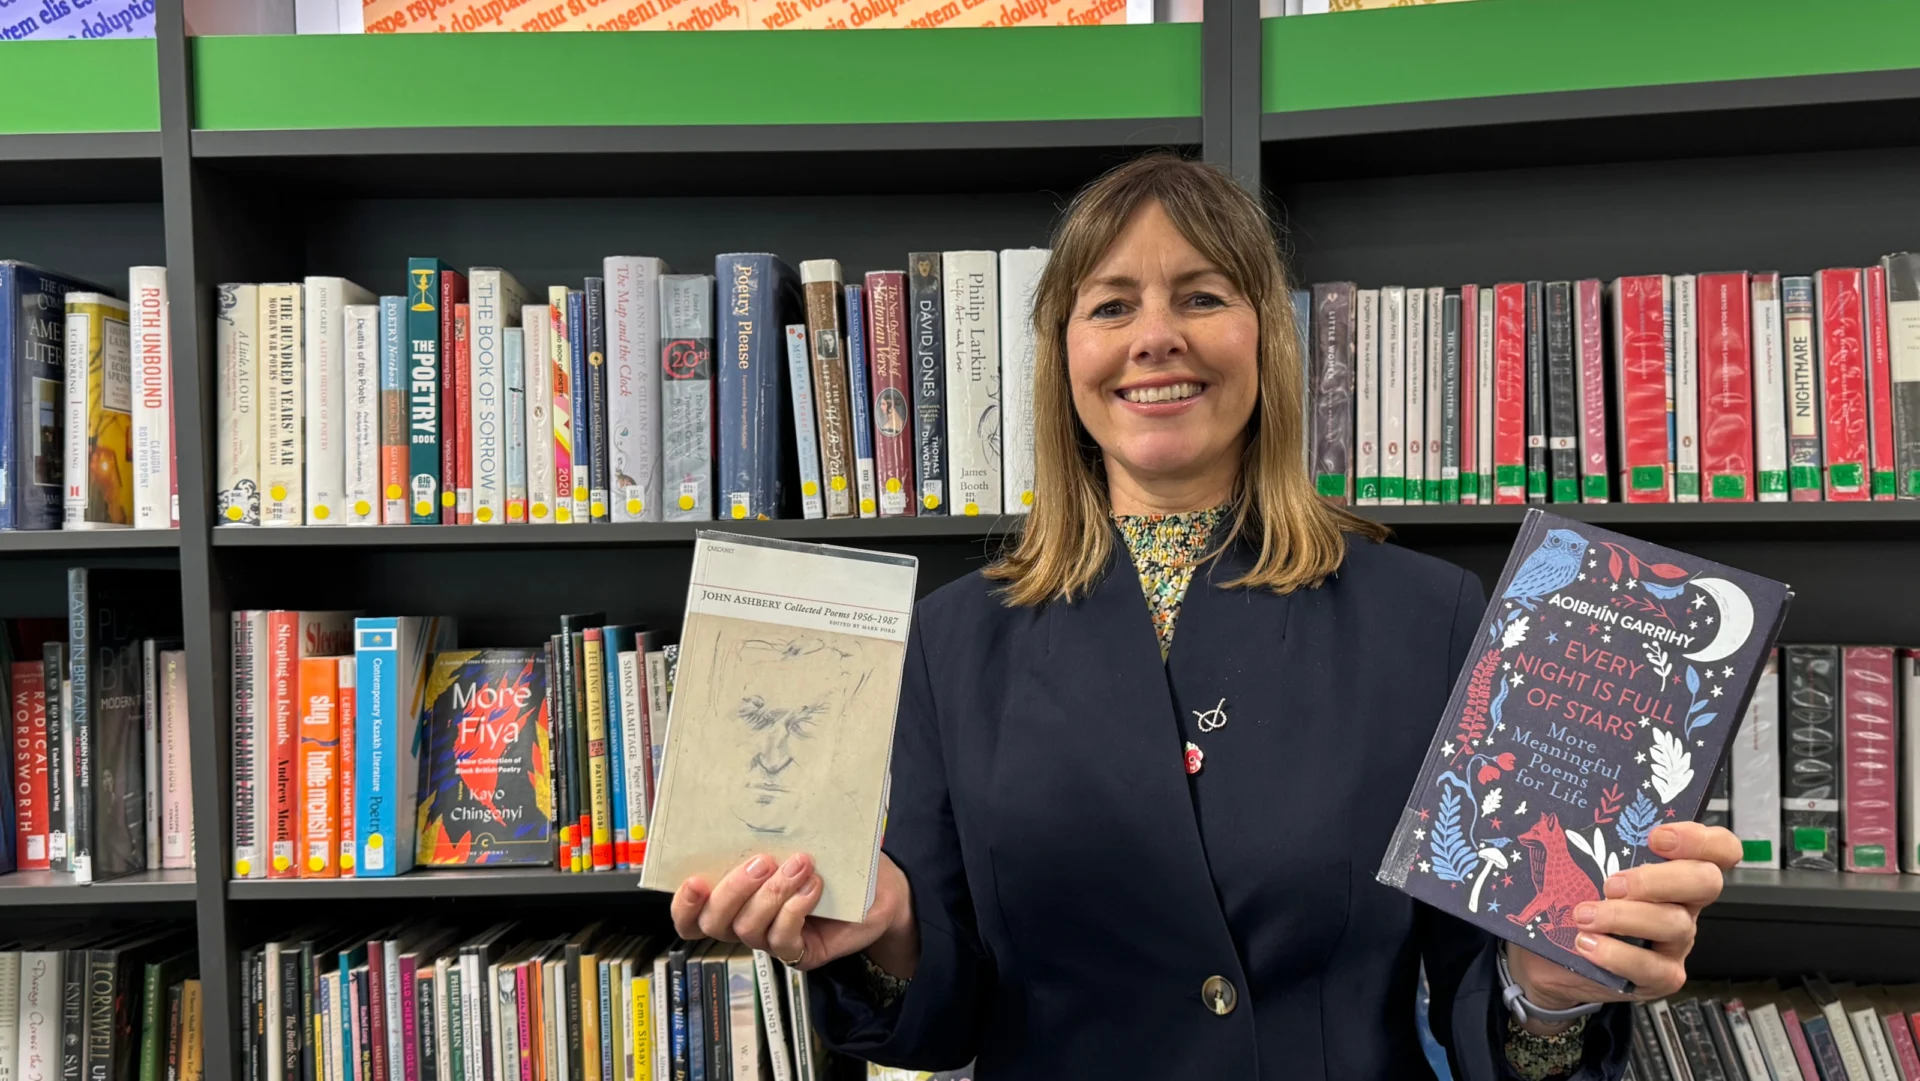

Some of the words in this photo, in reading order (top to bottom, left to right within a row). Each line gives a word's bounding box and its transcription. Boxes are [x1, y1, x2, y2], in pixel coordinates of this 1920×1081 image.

[763, 3, 800, 30] velit
[616, 264, 629, 288] The
[635, 264, 644, 300] CAROL
[736, 266, 753, 316] Poetry
[142, 288, 162, 328] ROTH
[280, 296, 293, 320] THE
[479, 284, 495, 320] THE
[590, 289, 601, 321] Empty
[616, 290, 629, 318] Map
[873, 281, 887, 344] Victorian
[966, 273, 984, 322] Philip
[388, 303, 398, 343] POETRY
[618, 321, 629, 342] and
[636, 304, 645, 328] ANN
[919, 300, 932, 346] DAVID
[1682, 302, 1690, 328] Bennett
[357, 318, 367, 349] Deaths
[412, 340, 435, 352] THE
[590, 324, 601, 347] Nest
[637, 333, 646, 368] DUFFY
[736, 321, 753, 370] Please
[280, 325, 293, 385] HUNDRED
[357, 351, 367, 360] of
[388, 345, 398, 388] Notebook
[479, 326, 495, 376] BOOK
[619, 344, 629, 362] the
[876, 347, 888, 377] Verse
[970, 329, 986, 382] Larkin
[142, 334, 162, 408] UNBOUND
[357, 361, 367, 376] the
[620, 364, 630, 397] Clock
[638, 372, 646, 382] &
[920, 351, 934, 397] JONES
[1793, 336, 1811, 418] NIGHTMARE
[357, 379, 367, 404] Poets
[411, 353, 435, 433] POETRY
[479, 383, 495, 406] OF
[639, 386, 647, 431] GILLIAN
[281, 438, 294, 466] WAR
[412, 435, 435, 444] BOOK
[479, 411, 495, 490] SORROW
[640, 435, 648, 478] CLARKE
[922, 431, 931, 479] DILWORTH
[931, 436, 940, 474] THOMAS
[558, 467, 569, 496] 2020
[961, 468, 986, 479] James
[961, 482, 989, 491] Booth
[73, 583, 87, 640] PLAYED
[702, 590, 731, 602] JOHN
[734, 594, 782, 609] ASHBERY
[784, 602, 822, 615] Collected
[823, 607, 851, 619] Poems
[1548, 593, 1620, 622] AOIBHÍN
[1620, 614, 1695, 649] GARRIHY
[829, 620, 851, 628] EDITED
[861, 624, 878, 632] MARK
[73, 644, 87, 660] IN
[275, 623, 290, 677] Sleeping
[1563, 640, 1645, 681] EVERY
[278, 680, 289, 696] on
[372, 658, 383, 716] Contemporary
[588, 650, 599, 694] TELLING
[623, 660, 635, 697] SIMON
[651, 660, 659, 684] Samuel
[1514, 651, 1591, 693] NIGHT
[1592, 678, 1616, 702] IS
[1617, 687, 1675, 726] FULL
[73, 665, 87, 723] BRITAIN
[304, 695, 335, 725] slug
[452, 681, 533, 710] More
[653, 686, 661, 712] Beckett
[278, 699, 290, 745] Islands
[590, 699, 600, 732] TALES
[626, 701, 637, 760] ARMITAGE
[1526, 687, 1563, 712] OF
[1563, 700, 1637, 741] STARS
[34, 691, 47, 775] RADICAL
[80, 726, 89, 757] MODERN
[372, 719, 383, 749] Kazakh
[461, 716, 520, 751] Fiya
[1546, 721, 1598, 754] More
[15, 692, 32, 832] WORDSWORTH
[307, 751, 333, 788] hollie
[1510, 726, 1622, 781] Meaningful
[1528, 752, 1589, 789] Poems
[80, 758, 89, 788] THEATRE
[372, 751, 383, 792] Literature
[1515, 768, 1545, 791] for
[1548, 780, 1588, 809] Life
[469, 788, 505, 803] Kayo
[307, 789, 333, 838] mcnish
[369, 796, 384, 835] Poetry
[450, 805, 523, 822] Chingonyi
[29, 960, 46, 1007] Passage
[284, 963, 296, 980] Paul
[403, 972, 412, 996] WILD
[673, 970, 683, 1002] Under
[759, 964, 768, 978] TO
[66, 982, 80, 1024] KNIFE
[284, 982, 296, 1009] Henry
[570, 982, 578, 1021] WILFRED
[637, 995, 646, 1027] Lemn
[762, 982, 778, 1035] INKLANDT
[29, 1012, 44, 1051] Across
[90, 970, 113, 1062] CORNWELL
[286, 1014, 296, 1029] The
[404, 1000, 413, 1036] CHERRY
[674, 1006, 683, 1030] Milk
[286, 1030, 297, 1053] Brittle
[406, 1043, 414, 1074] NIGEL
[638, 1031, 647, 1066] Sissay
[675, 1035, 684, 1063] Wood
[30, 1055, 43, 1069] the
[287, 1054, 297, 1069] Sea
[774, 1050, 783, 1077] SOPHIE
